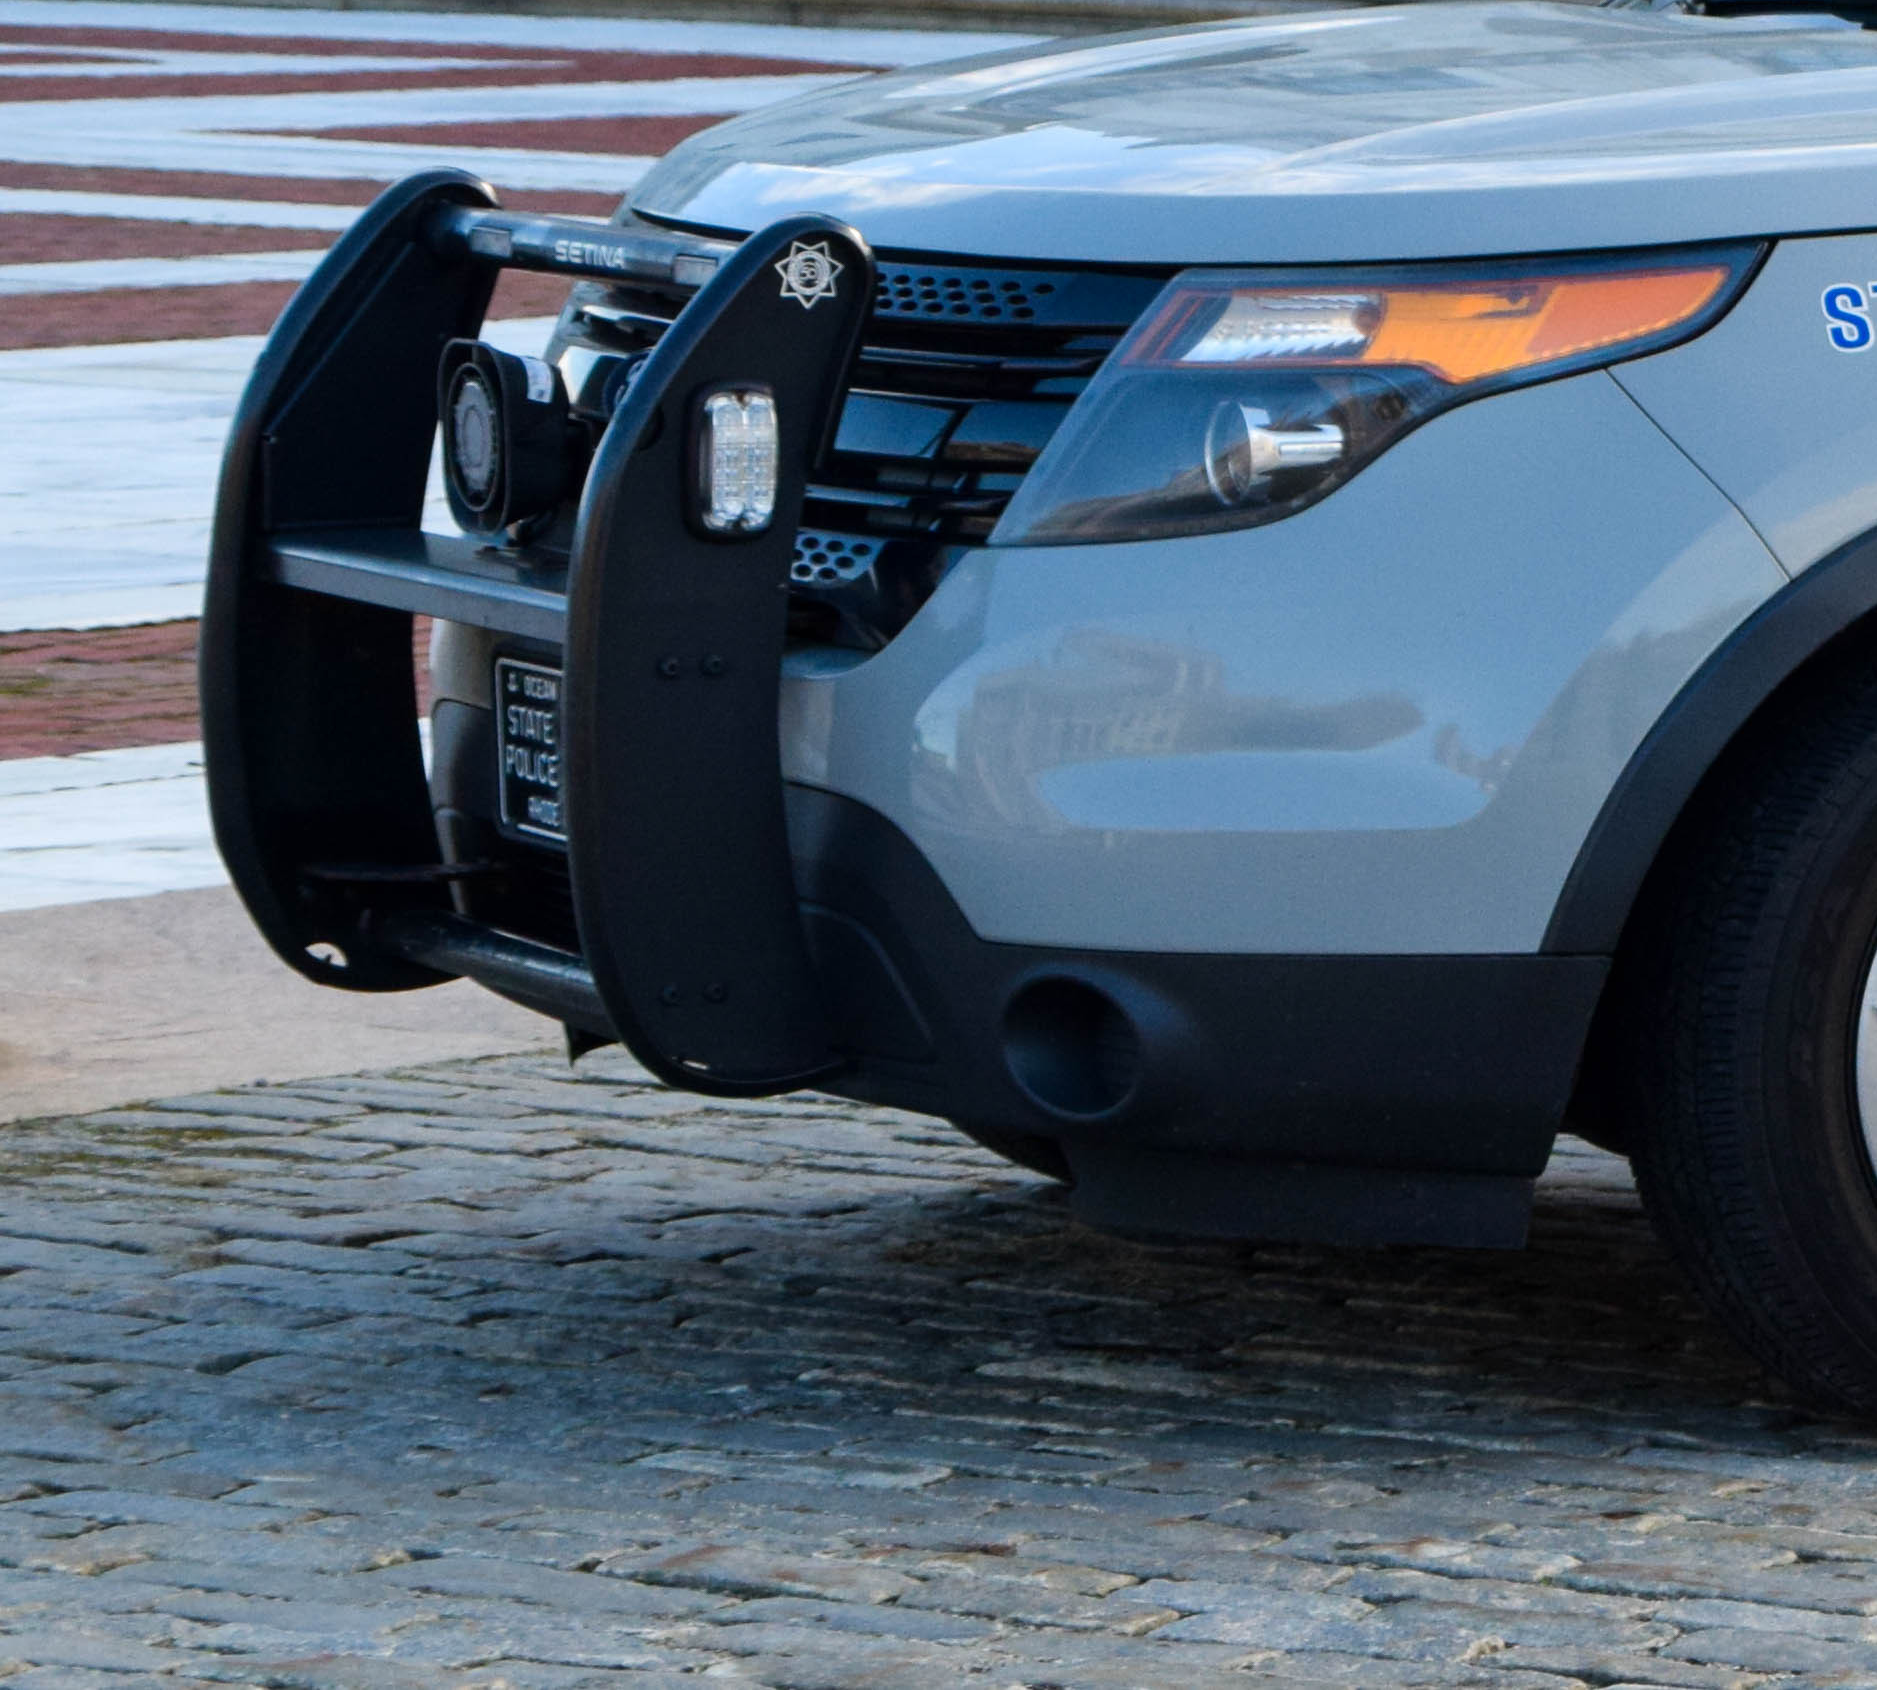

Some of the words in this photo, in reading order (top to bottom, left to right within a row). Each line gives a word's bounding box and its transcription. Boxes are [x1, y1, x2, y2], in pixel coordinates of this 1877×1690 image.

[555, 239, 626, 269] SETINA
[507, 705, 556, 745] STATE
[506, 743, 560, 788] POLICE
